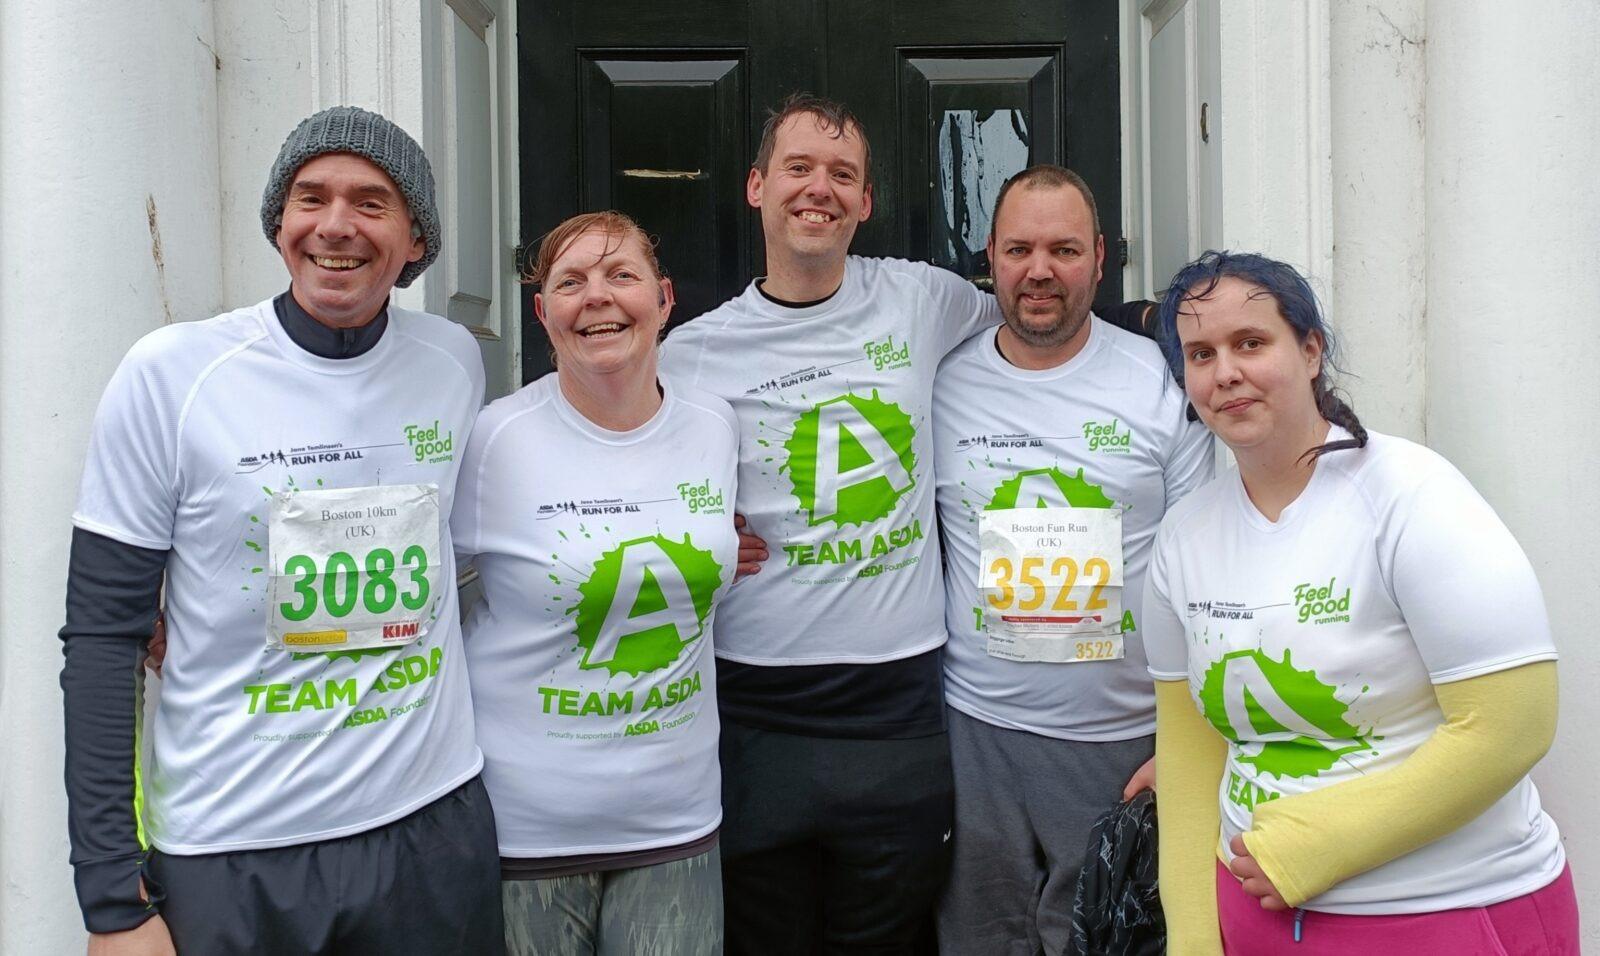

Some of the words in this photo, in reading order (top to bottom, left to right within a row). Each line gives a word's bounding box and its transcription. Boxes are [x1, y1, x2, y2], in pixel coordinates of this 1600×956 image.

[863, 335, 893, 360] Feel
[874, 341, 909, 371] good
[888, 360, 912, 371] running
[781, 378, 799, 388] RUN
[800, 374, 816, 383] FOR
[818, 369, 832, 378] ALL
[404, 421, 439, 446] Feel
[1082, 419, 1118, 439] Feel
[1089, 429, 1131, 451] good
[415, 431, 452, 462] good
[291, 455, 316, 466] RUN
[319, 453, 340, 463] FOR
[344, 450, 364, 460] ALL
[429, 454, 453, 465] running
[813, 400, 913, 520] A
[677, 478, 710, 500] Feel
[581, 507, 602, 515] RUN
[604, 506, 622, 514] FOR
[625, 505, 641, 513] ALL
[689, 488, 723, 513] good
[321, 509, 362, 522] Boston
[367, 506, 397, 518] 10km
[346, 525, 376, 539] (UK)
[1011, 523, 1044, 533] Boston
[1047, 523, 1065, 533] Fun
[1068, 523, 1088, 533] Run
[782, 539, 862, 567] TEAM
[870, 519, 924, 558] ASDA
[1036, 538, 1062, 548] (UK)
[280, 544, 430, 622] 3083
[987, 556, 1111, 611] 3522
[1293, 577, 1336, 606] Feel
[586, 540, 701, 665] A
[1298, 587, 1351, 624] good
[1212, 609, 1227, 619] RUN
[1227, 611, 1241, 620] FOR
[1241, 611, 1254, 620] ALL
[1314, 614, 1350, 625] running
[1075, 640, 1114, 660] 3522
[243, 678, 357, 715] TEAM
[537, 687, 634, 716] TEAM
[640, 670, 702, 713] ASDA
[342, 706, 388, 728] ASDA
[623, 719, 661, 737] ASDA
[1228, 772, 1281, 813] EAM
